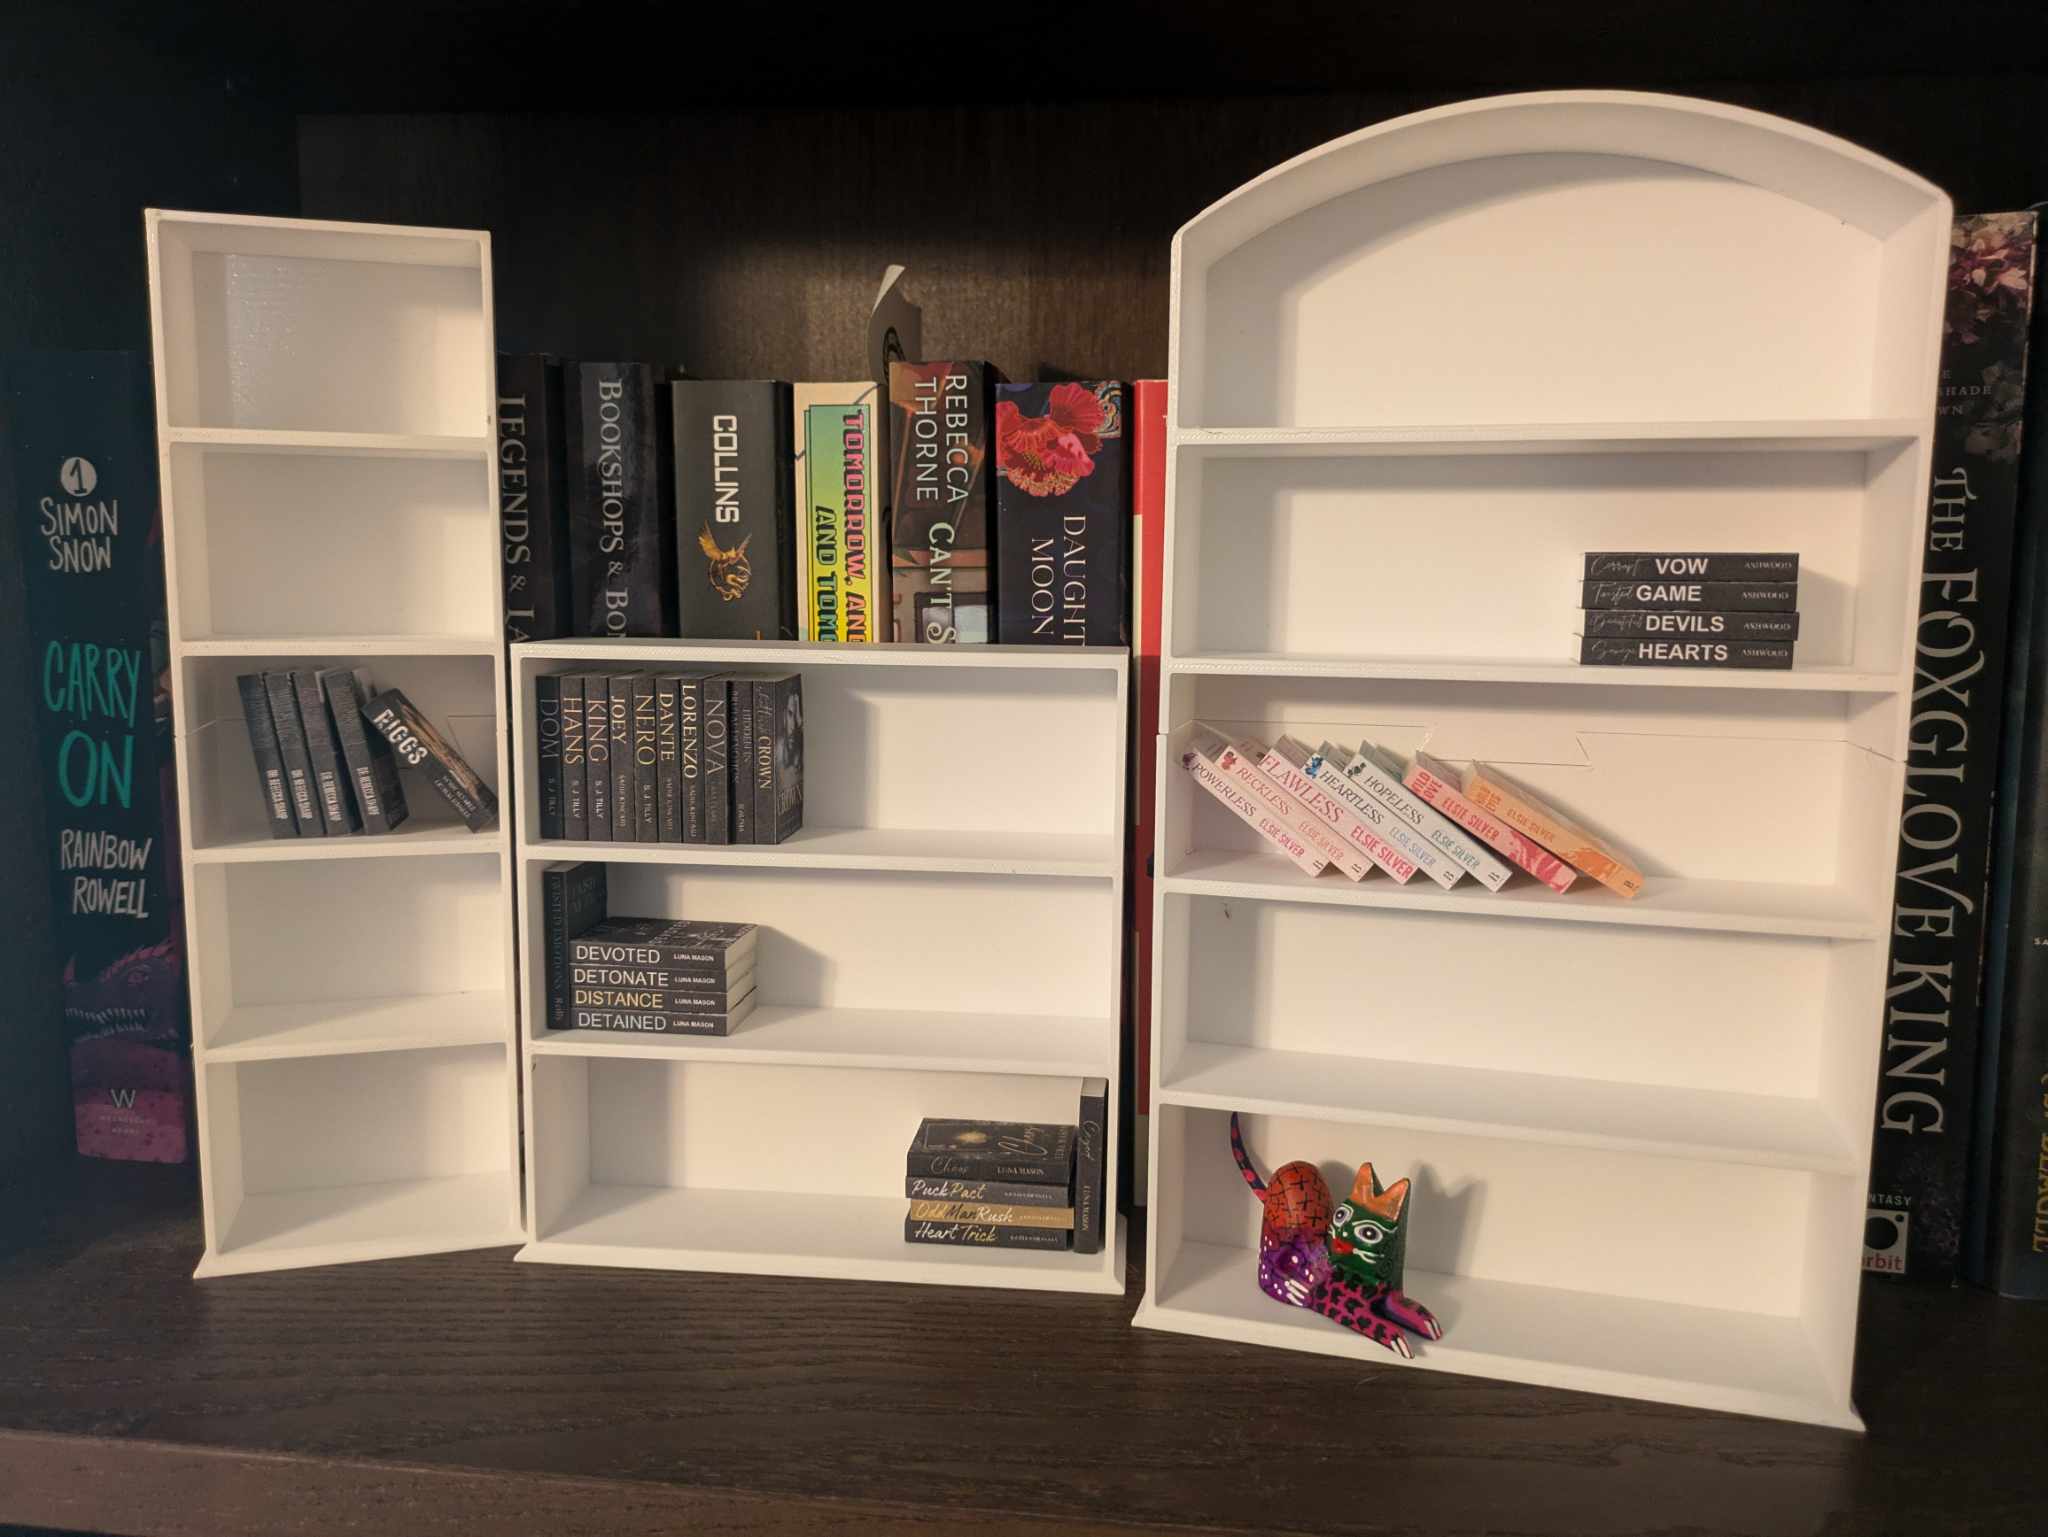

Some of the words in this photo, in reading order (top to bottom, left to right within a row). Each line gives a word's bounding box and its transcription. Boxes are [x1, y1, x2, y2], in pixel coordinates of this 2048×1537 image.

[599, 378, 624, 553] BOOKSHOPS
[914, 376, 938, 501] THORNE
[944, 374, 969, 503] REBECCA
[713, 415, 740, 523] COLLINS
[40, 497, 118, 536] SIMON
[815, 505, 837, 566] AND
[1929, 467, 1979, 552] THE
[49, 535, 111, 573] SNOW
[608, 561, 624, 576] &
[929, 522, 955, 608] CAN'T
[1656, 559, 1708, 574] VOW
[1031, 537, 1055, 635] MOON
[1636, 585, 1702, 601] GAME
[1646, 616, 1724, 632] DEVILS
[1639, 644, 1728, 660] HEARTS
[44, 640, 140, 728] CARRY
[372, 708, 428, 766] RIGGS
[540, 699, 560, 759] DOM
[563, 697, 584, 764] HANS
[588, 700, 608, 762] KING
[611, 696, 627, 744] JOEY
[635, 695, 656, 765] NERO
[660, 693, 675, 761] DANTE
[682, 685, 697, 778] LORENZO
[705, 699, 726, 775] NOVA
[58, 729, 136, 808] ON
[759, 736, 772, 791] CROWN
[1894, 567, 1985, 938] FOXGLOVE
[1192, 763, 1257, 817] POWERLESS
[1259, 818, 1281, 838] ELSIE
[1278, 833, 1305, 858] SILVER
[1236, 767, 1289, 816] RECKLESS
[1260, 753, 1344, 823] FLAWLESS
[1351, 825, 1382, 851] ELSIE
[1378, 846, 1414, 879] SILVER
[1320, 770, 1384, 824] HEARTLESS
[1364, 775, 1424, 825] HOPELESS
[1431, 830, 1455, 851] ELSIE
[1451, 844, 1481, 870] SILVER
[1441, 799, 1466, 820] ELSIE
[1467, 814, 1500, 841] SILVER
[61, 829, 152, 870] RAINBOW
[72, 875, 149, 919] ROWELL
[575, 969, 669, 987] DETONATE
[576, 945, 660, 964] DEVOTED
[575, 990, 664, 1008] DISTANCE
[578, 1012, 666, 1031] DETAINED
[692, 1021, 714, 1029] MASON
[1880, 958, 1953, 1134] KING
[110, 1088, 136, 1109] W
[912, 1179, 949, 1197] Puck
[950, 1183, 987, 1200] Pact
[915, 1203, 951, 1219] Odd
[945, 1204, 977, 1220] Man
[976, 1207, 1013, 1223] Rush
[914, 1222, 959, 1240] Heart
[960, 1225, 998, 1242] Trick
[1861, 1253, 1904, 1271] rbit
